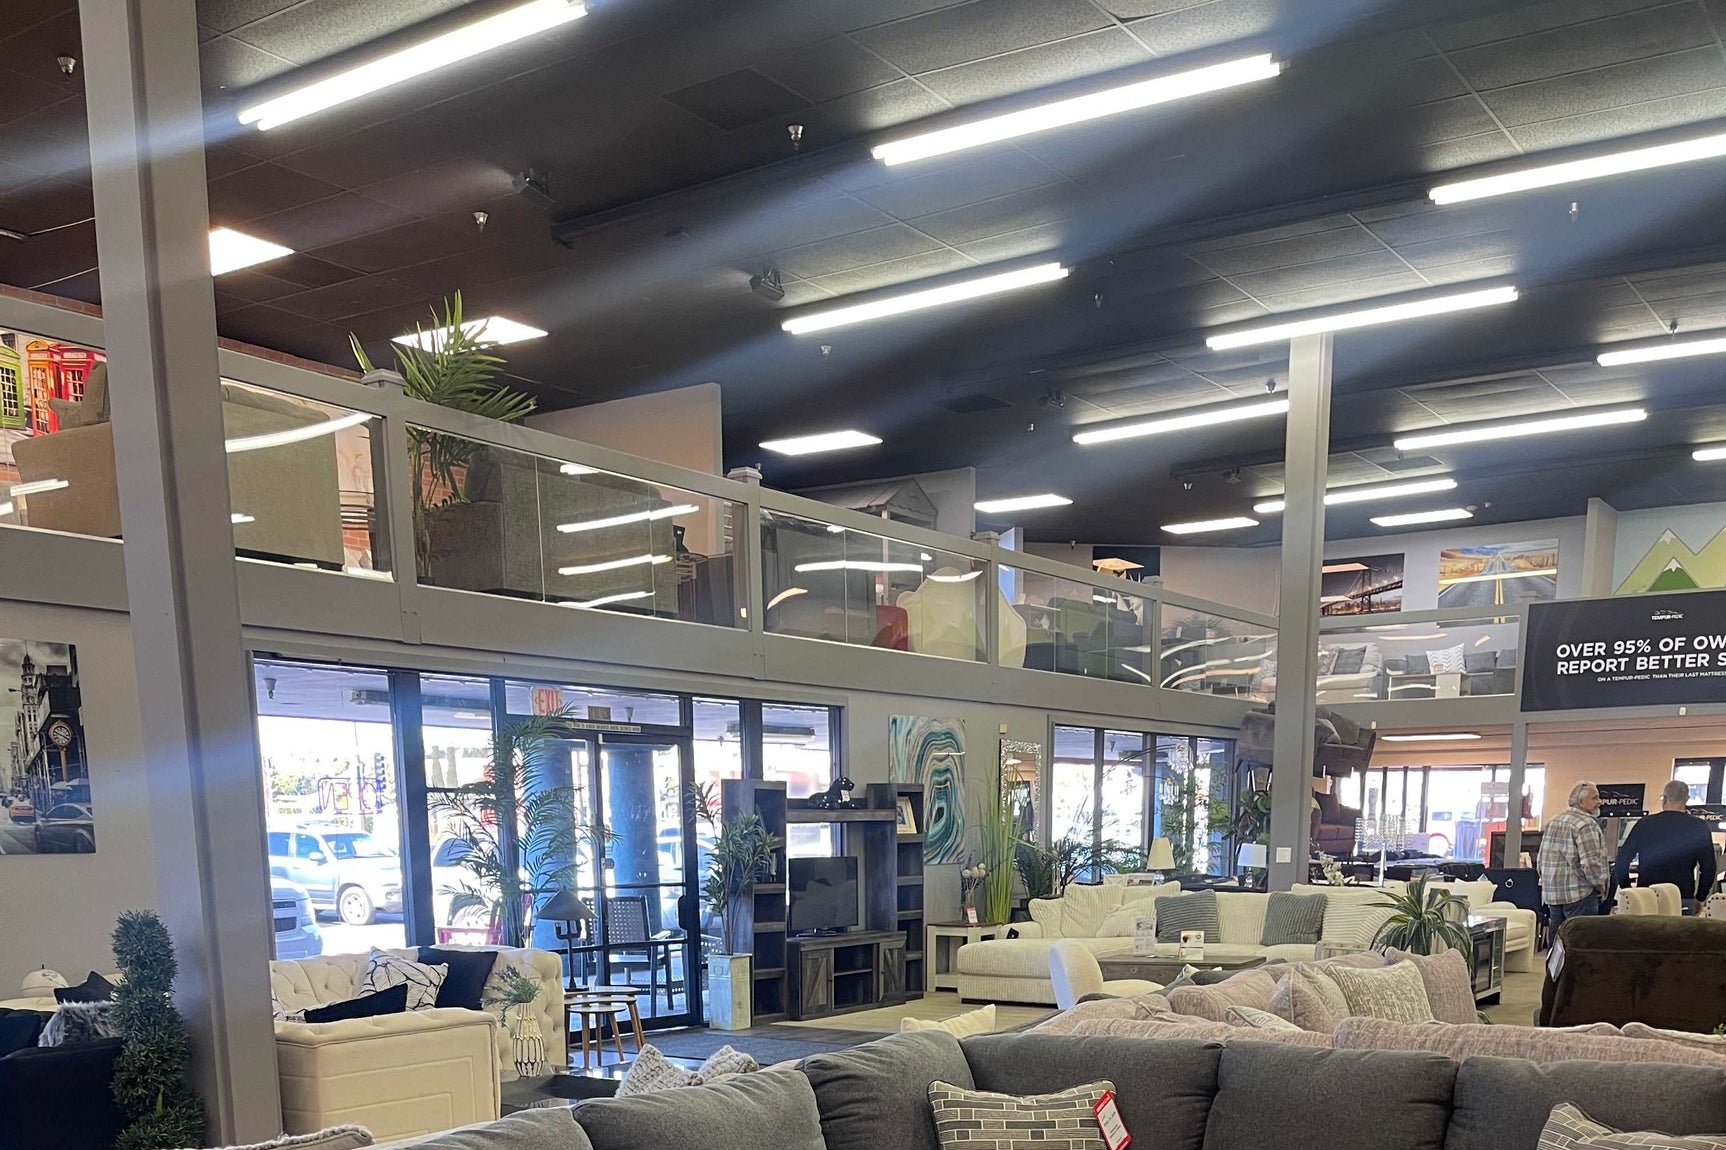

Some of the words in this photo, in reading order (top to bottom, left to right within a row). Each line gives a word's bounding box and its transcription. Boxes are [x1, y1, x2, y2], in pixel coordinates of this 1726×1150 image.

[1556, 642, 1606, 658] OVER
[1614, 639, 1651, 655] 95%
[1659, 637, 1687, 652] OF
[1556, 657, 1629, 675] REPORT
[1636, 653, 1710, 671] BETTER
[538, 688, 560, 713] EXIT
